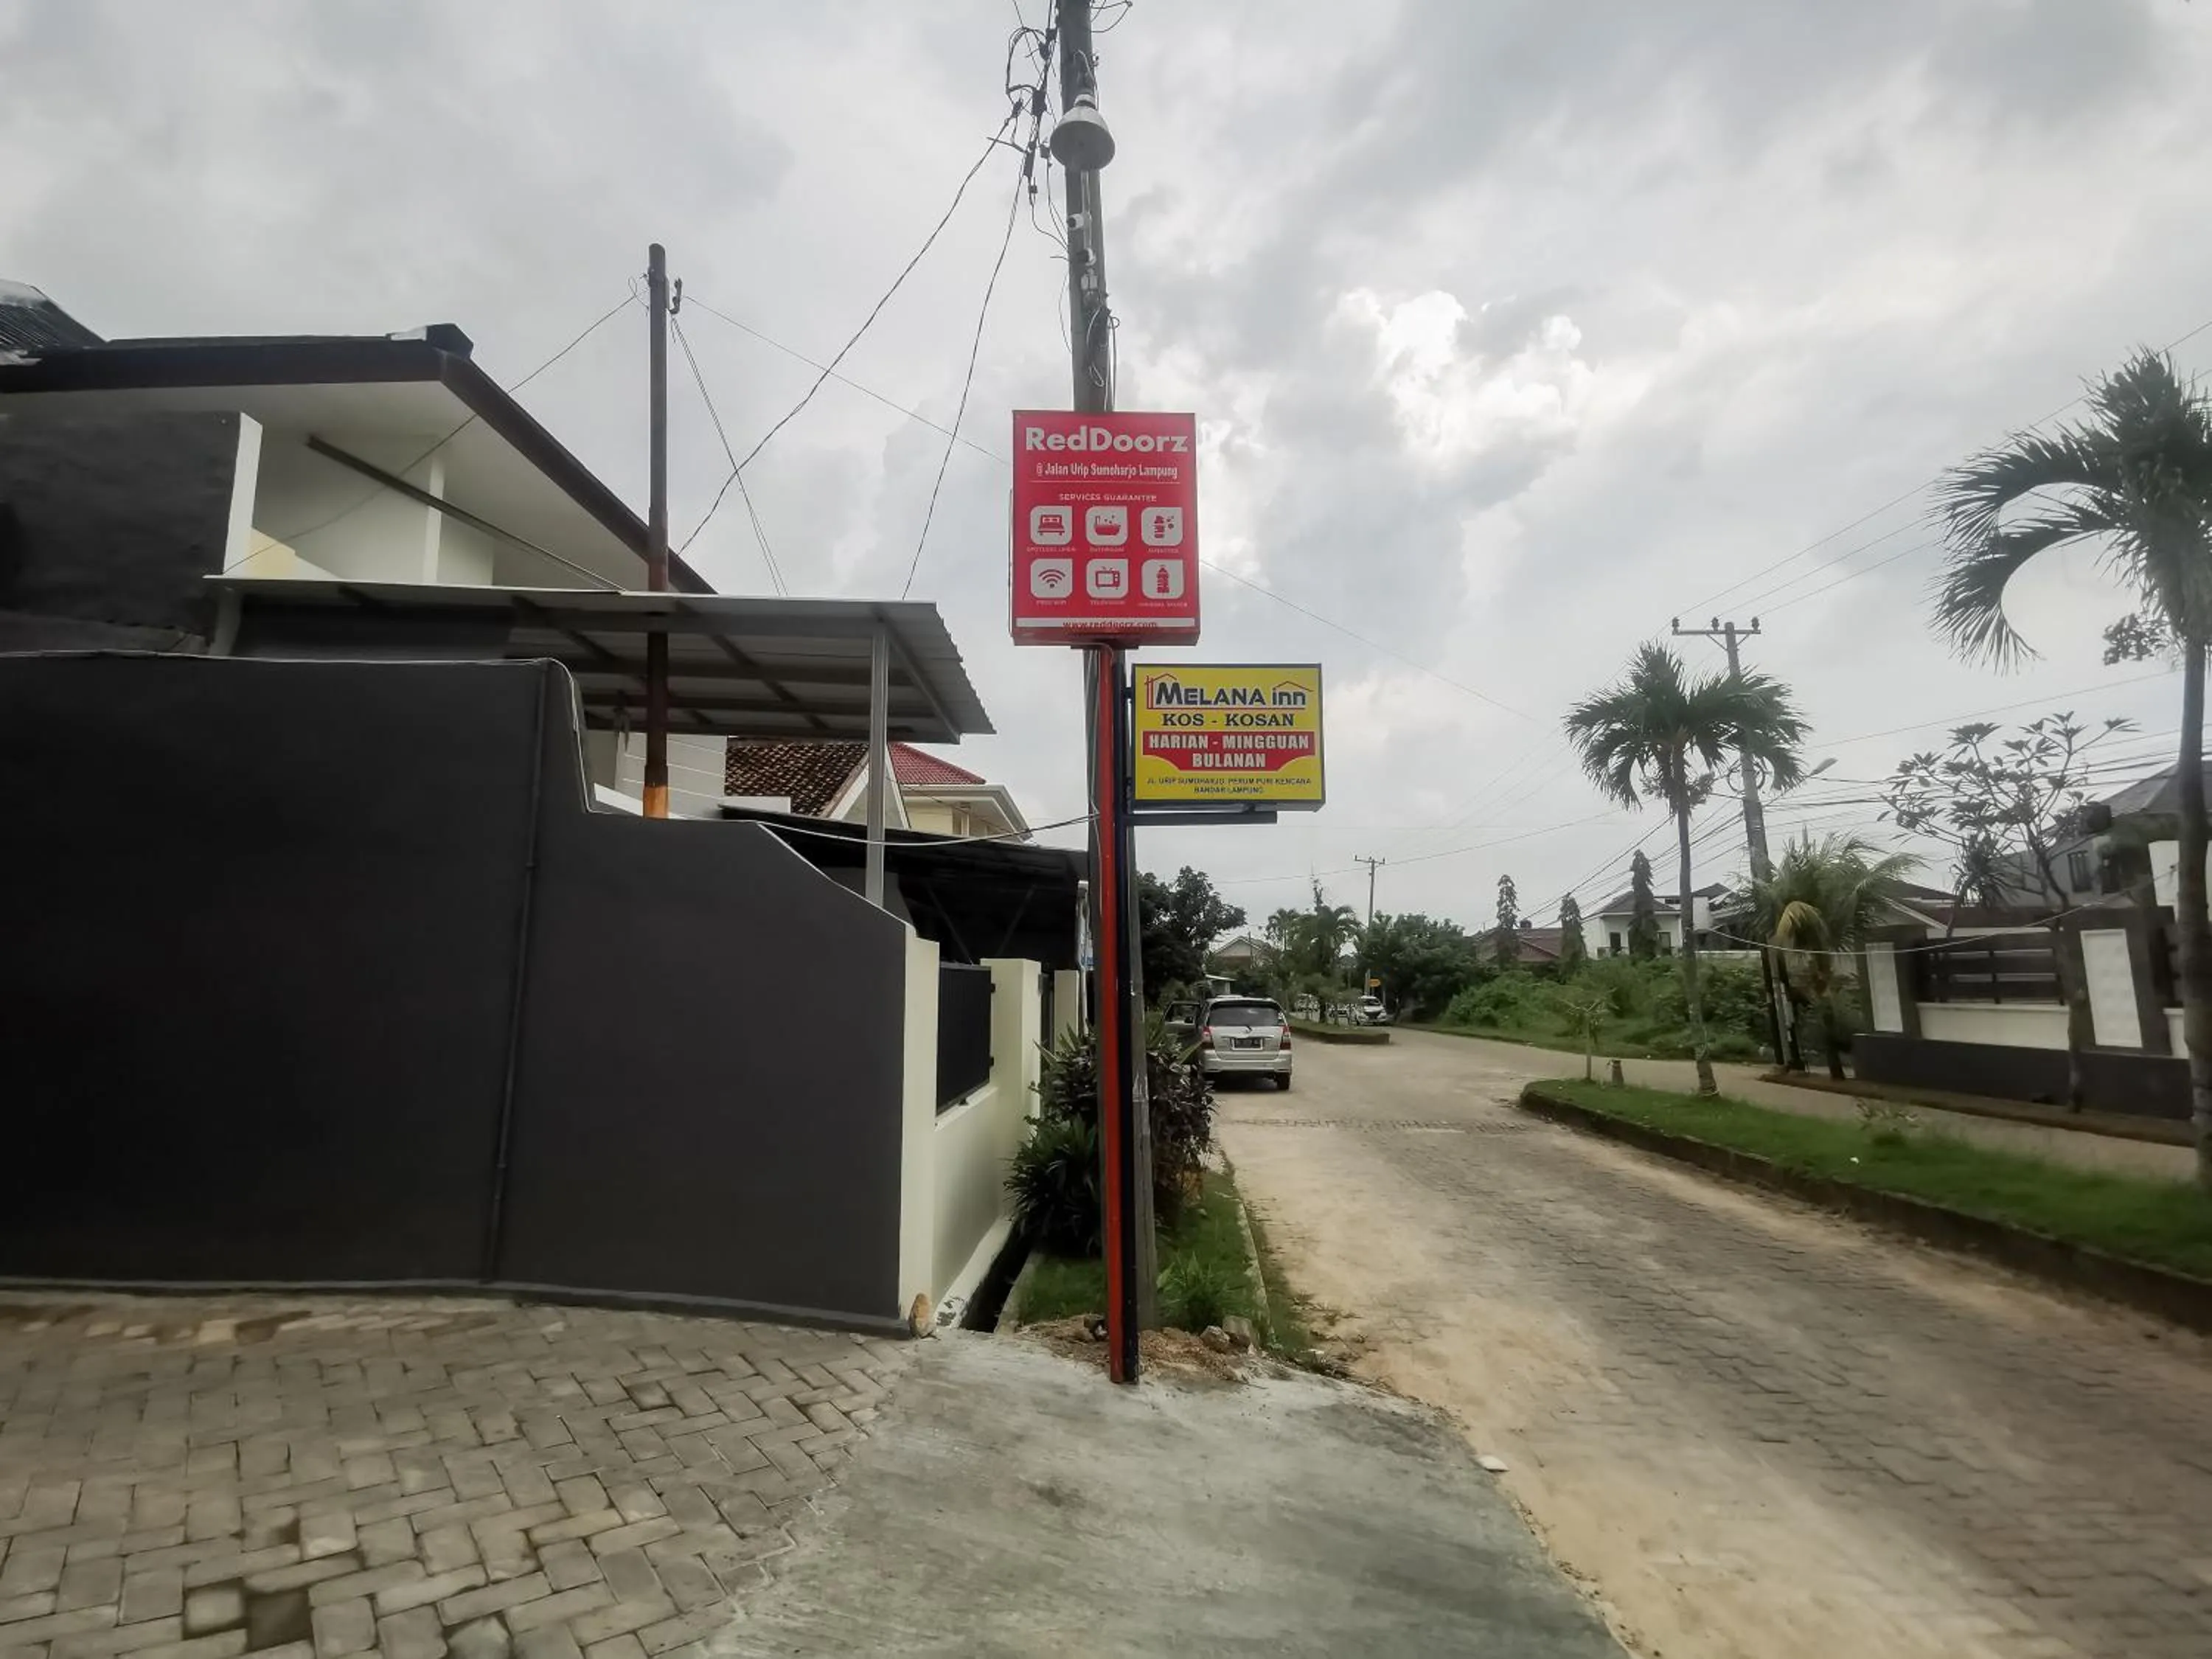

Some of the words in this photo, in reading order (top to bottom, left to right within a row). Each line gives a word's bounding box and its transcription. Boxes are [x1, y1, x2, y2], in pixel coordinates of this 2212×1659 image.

[1026, 425, 1189, 453] RedDoorz
[1045, 462, 1068, 476] Jalan
[1071, 462, 1089, 479] Urip
[1091, 463, 1136, 479] Sumoharjo
[1139, 464, 1178, 480] Lampung
[1059, 493, 1102, 501] SERVICES
[1104, 494, 1158, 502] GUARANTEE
[1155, 682, 1266, 706] MELANA
[1162, 713, 1205, 726] KOS
[1224, 713, 1295, 726] KOSAN
[1149, 734, 1208, 749] HARIAN
[1222, 734, 1309, 749] MINGGUAN
[1192, 753, 1266, 768] BULANAN
